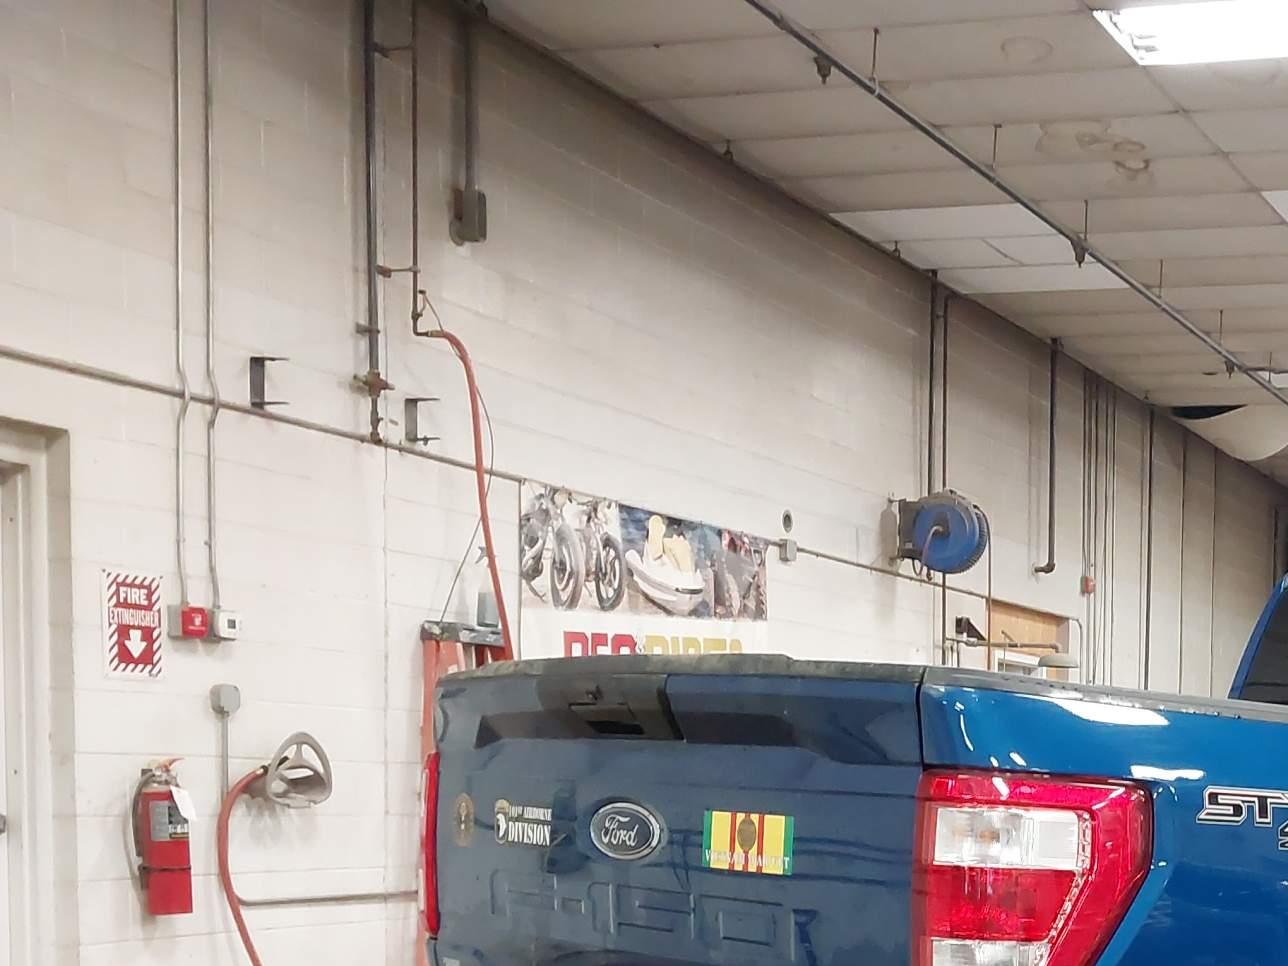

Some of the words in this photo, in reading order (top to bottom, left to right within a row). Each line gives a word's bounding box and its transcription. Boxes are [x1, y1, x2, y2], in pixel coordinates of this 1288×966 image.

[119, 585, 149, 606] FIRE
[109, 606, 160, 628] EXTINGUISHER
[507, 821, 552, 847] DIVISION
[601, 814, 640, 848] Ford
